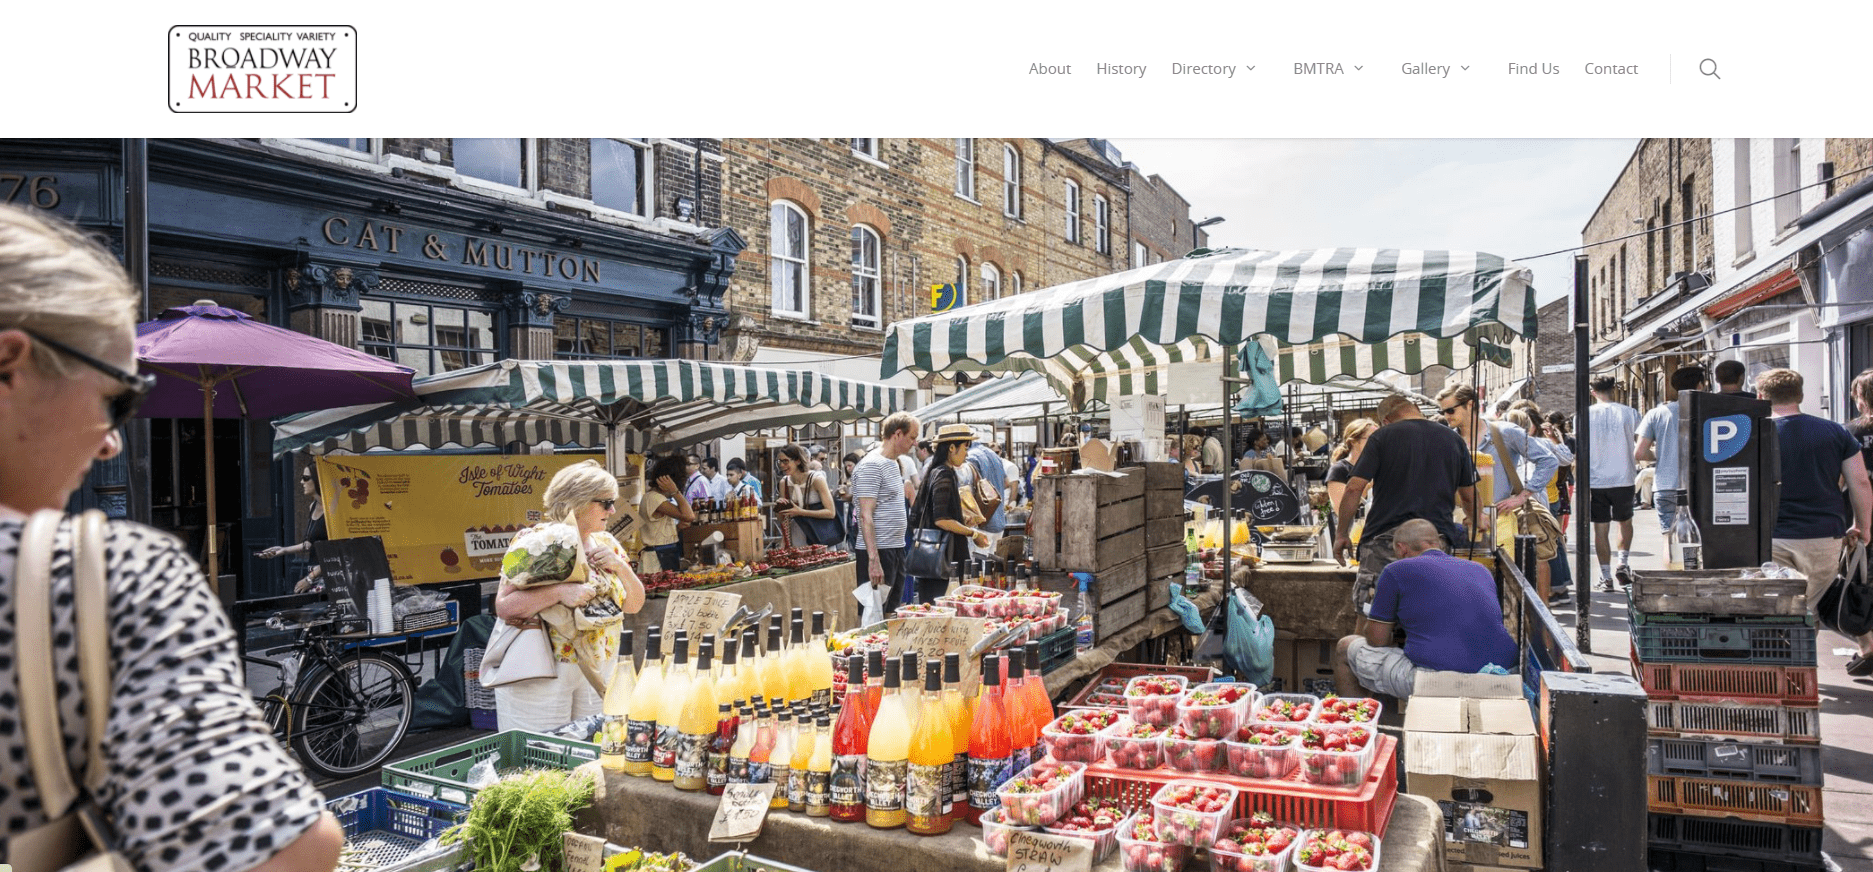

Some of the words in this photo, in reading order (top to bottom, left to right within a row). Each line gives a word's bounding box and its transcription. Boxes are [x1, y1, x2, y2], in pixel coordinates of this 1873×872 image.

[323, 217, 403, 254] CAT
[424, 234, 449, 261] &
[464, 237, 601, 284] MUTTON
[1710, 420, 1738, 454] P
[459, 465, 488, 484] Isle
[490, 464, 503, 481] of
[504, 463, 547, 485] Wight
[472, 480, 533, 498] Tomatoes
[896, 621, 920, 640] Apple
[1015, 848, 1062, 866] STRAW
[1511, 852, 1531, 860] juices
